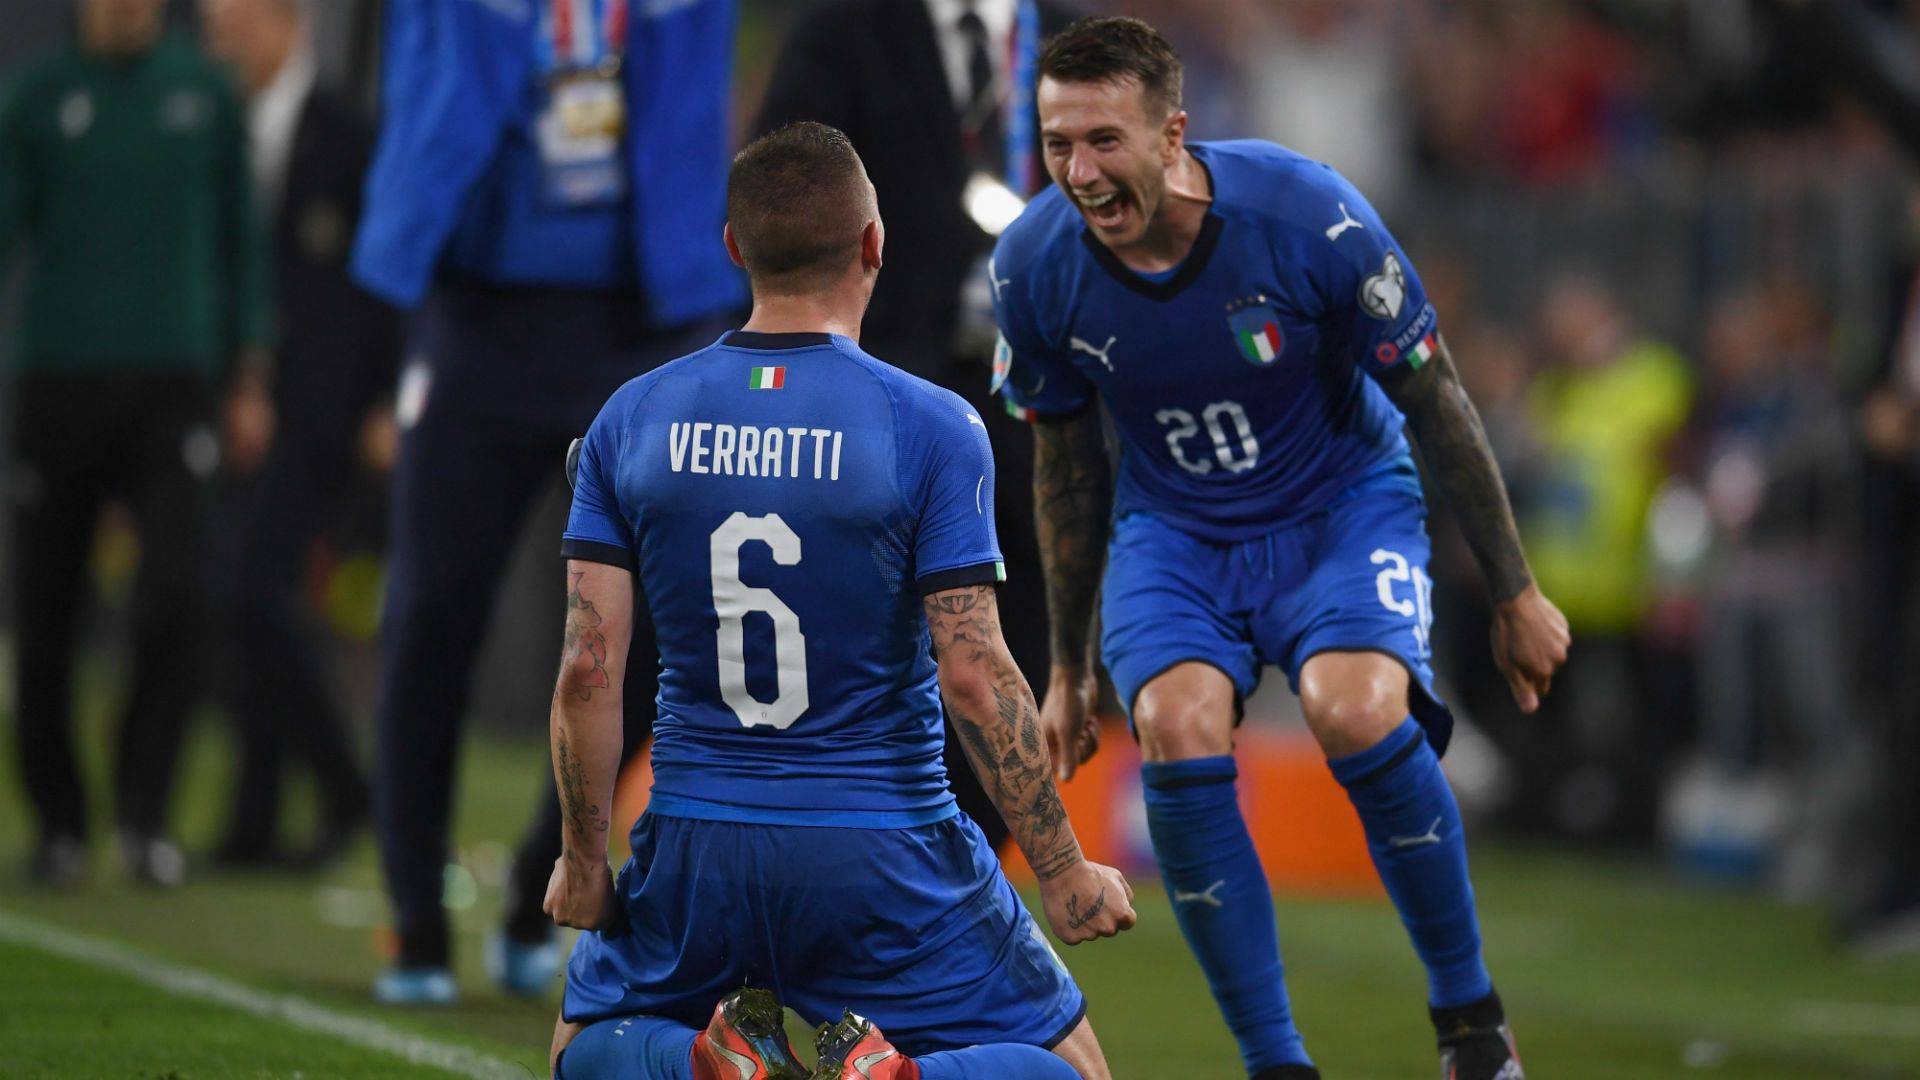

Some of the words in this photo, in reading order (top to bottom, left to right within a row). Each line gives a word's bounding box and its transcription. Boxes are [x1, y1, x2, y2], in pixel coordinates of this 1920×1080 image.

[669, 422, 843, 481] VERRATTI
[1154, 400, 1260, 475] 20
[710, 511, 810, 730] 6
